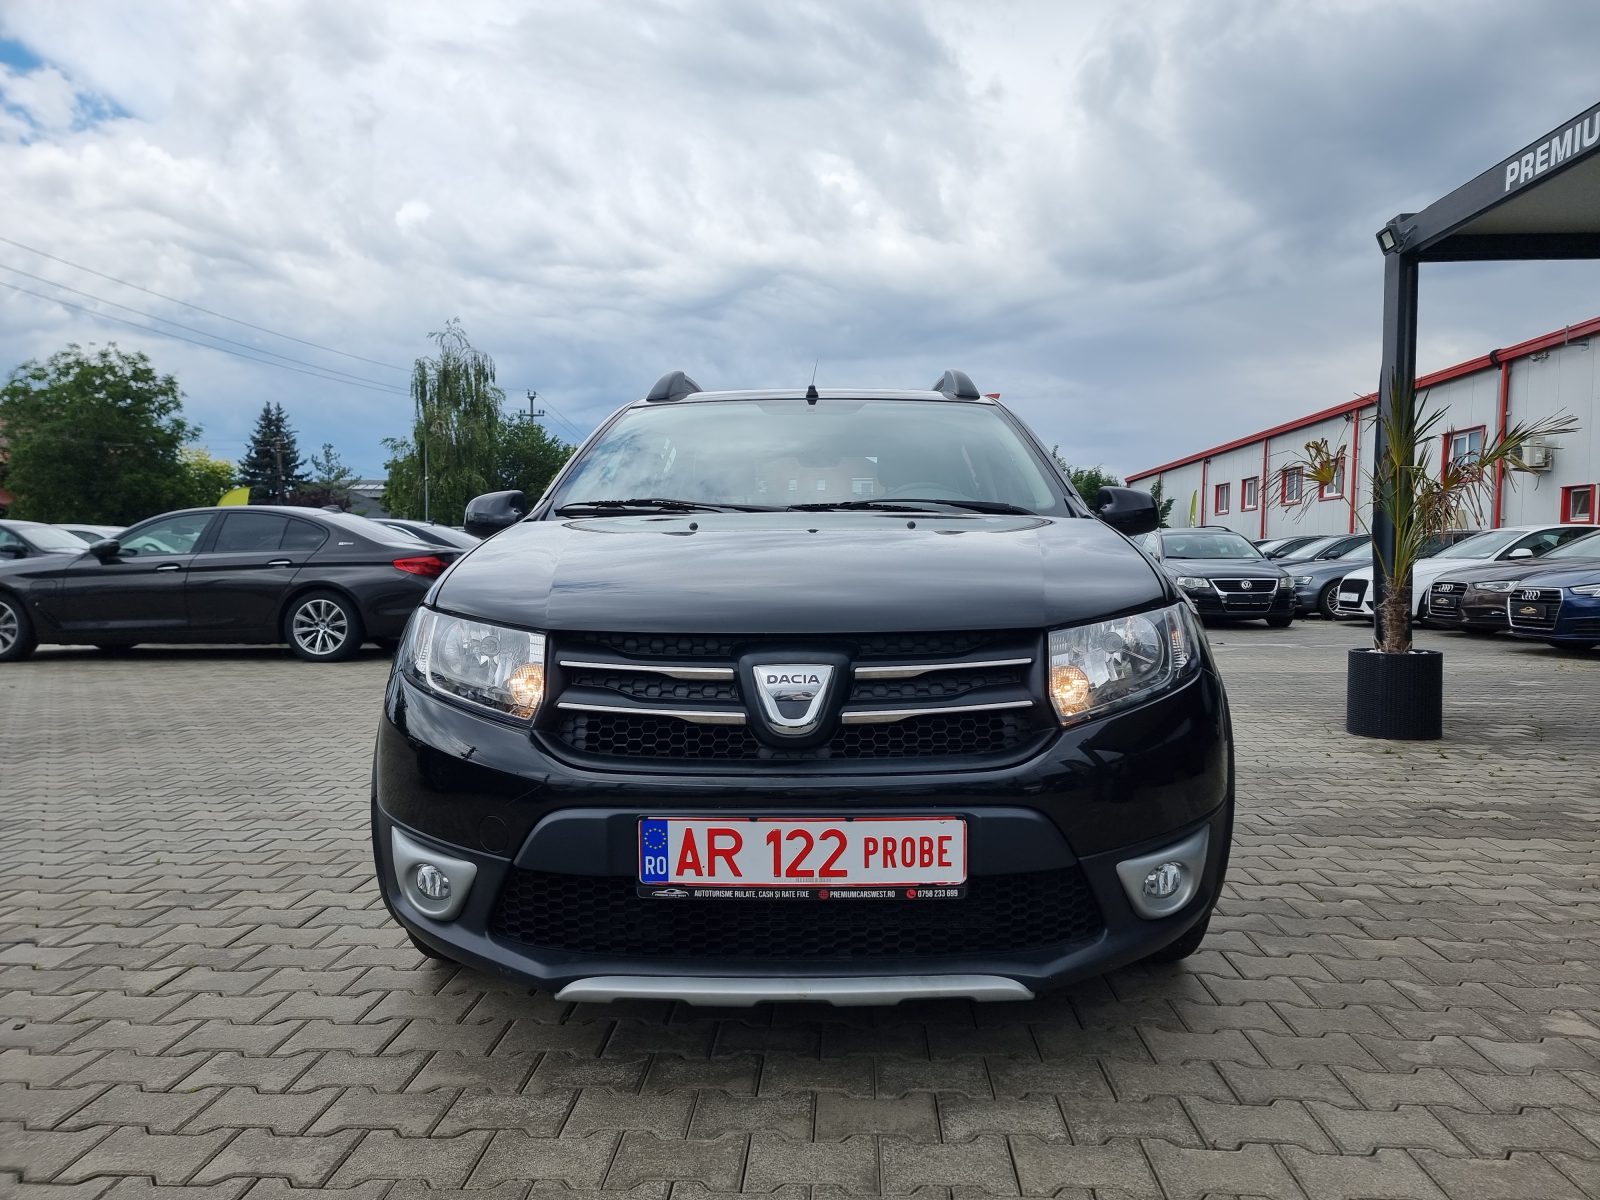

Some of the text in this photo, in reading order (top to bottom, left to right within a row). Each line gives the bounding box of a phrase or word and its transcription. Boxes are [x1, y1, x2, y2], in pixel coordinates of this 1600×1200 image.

[767, 674, 820, 684] DACIA
[675, 827, 952, 878] AR 122 PROBE
[645, 856, 667, 875] RO
[694, 890, 733, 898] AUTOTURISME
[829, 890, 896, 898] PREMIUMCARSWEST.RO
